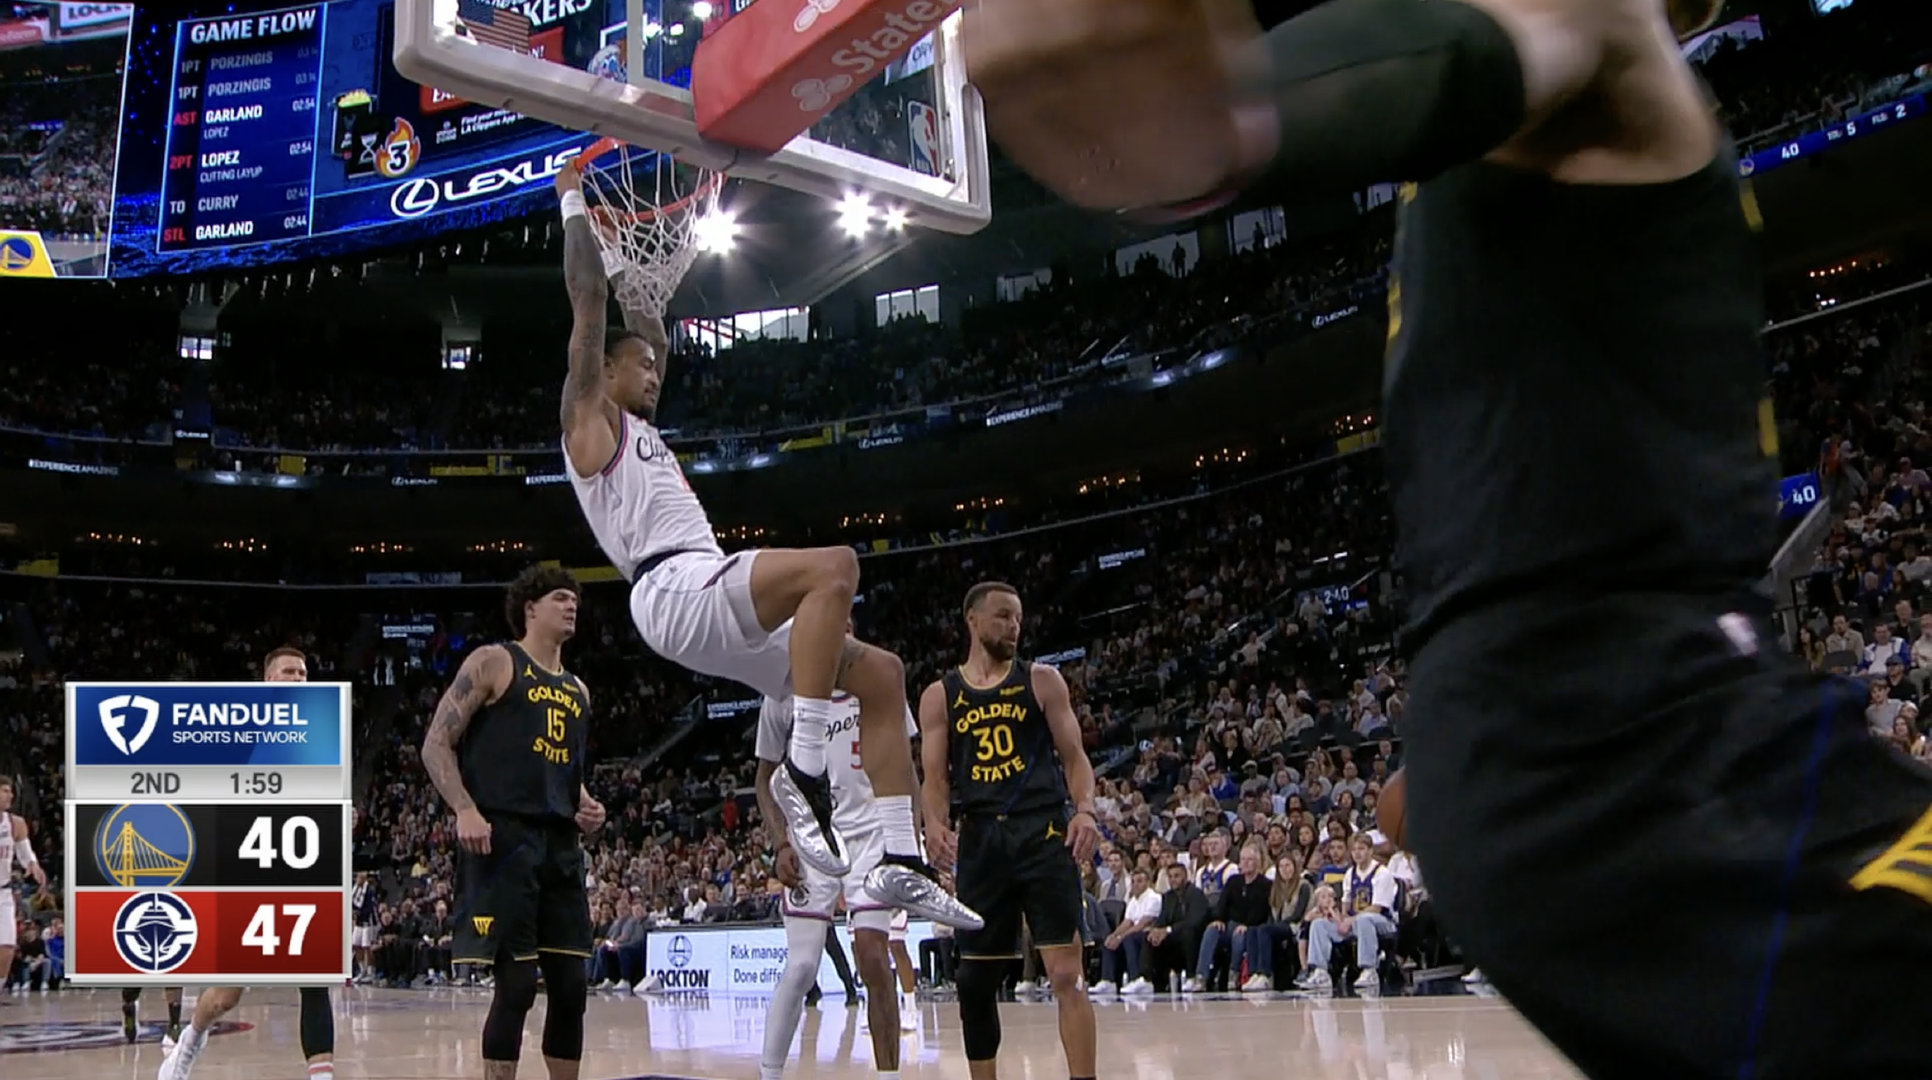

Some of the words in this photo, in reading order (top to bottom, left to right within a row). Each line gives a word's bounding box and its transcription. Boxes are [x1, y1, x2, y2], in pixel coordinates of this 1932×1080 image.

[191, 19, 252, 44] GAME
[258, 9, 316, 36] FLOW
[832, 0, 941, 75] State
[181, 60, 199, 73] 1PT
[211, 51, 273, 70] PORZINGIS
[178, 86, 198, 99] 1PT
[208, 78, 272, 97] PORZINGIS
[173, 111, 197, 125] AST
[205, 105, 263, 124] GARLAND
[203, 126, 229, 140] LOPEZ
[1782, 142, 1799, 158] 40
[1846, 121, 1856, 136] 5
[1895, 103, 1906, 119] 2
[169, 155, 193, 170] 2PT
[201, 150, 240, 168] LOPEZ
[388, 141, 410, 173] 3
[200, 169, 235, 183] CUTTING
[236, 166, 263, 179] LAYUP
[444, 147, 581, 201] LEXUS
[169, 200, 186, 214] TO
[197, 195, 239, 211] CURRY
[163, 227, 186, 242] STL
[195, 221, 254, 240] GARLAND
[1792, 485, 1815, 505] 40
[528, 685, 582, 718] GOLDEN
[547, 707, 567, 742] 15
[956, 703, 1028, 734] GOLDEN
[533, 737, 570, 764] STATE
[972, 725, 1014, 761] 30
[971, 756, 1026, 783] STATE
[730, 944, 751, 959] Risk
[734, 968, 757, 983] Done
